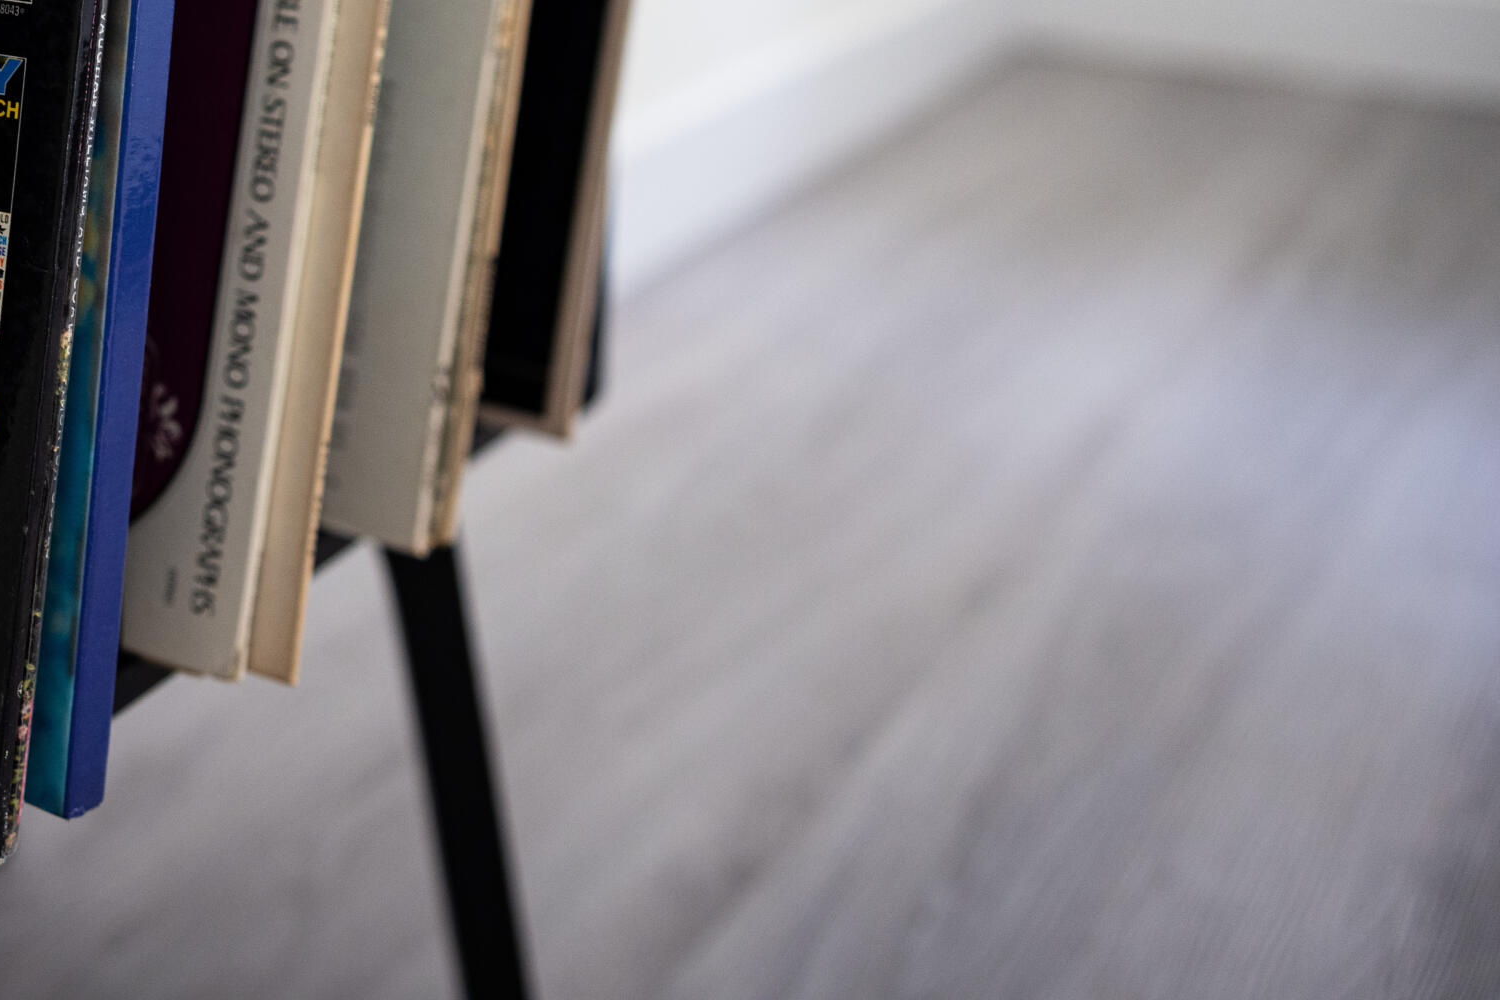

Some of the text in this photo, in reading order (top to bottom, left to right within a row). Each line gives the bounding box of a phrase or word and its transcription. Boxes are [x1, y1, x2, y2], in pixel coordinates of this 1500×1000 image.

[266, 39, 296, 90] ON
[250, 95, 289, 204] STEREO
[238, 210, 269, 281] AND
[224, 286, 261, 391] MONO
[188, 393, 246, 619] PHONOGRAPHS
